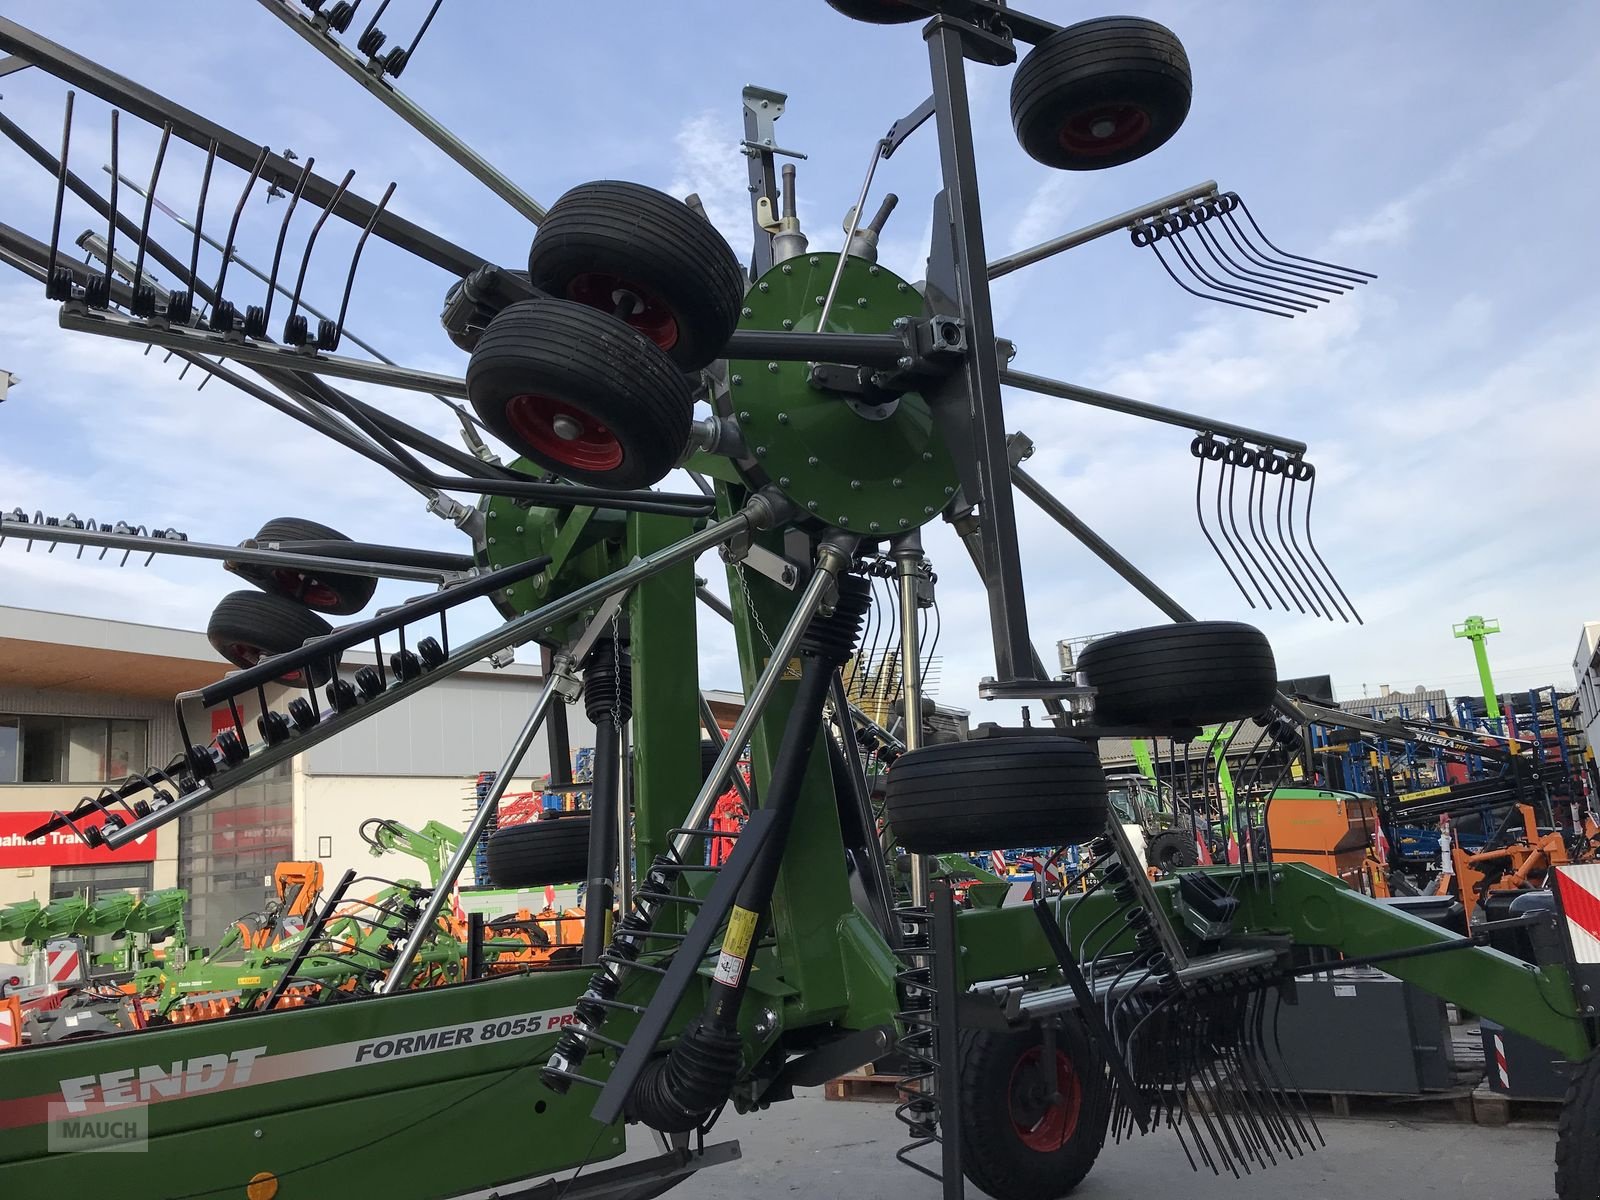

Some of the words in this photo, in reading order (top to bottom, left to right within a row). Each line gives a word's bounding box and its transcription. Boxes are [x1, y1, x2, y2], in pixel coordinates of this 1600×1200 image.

[355, 1027, 474, 1063] FORMER
[480, 1015, 542, 1041] 8055
[59, 1046, 268, 1114] FENDT
